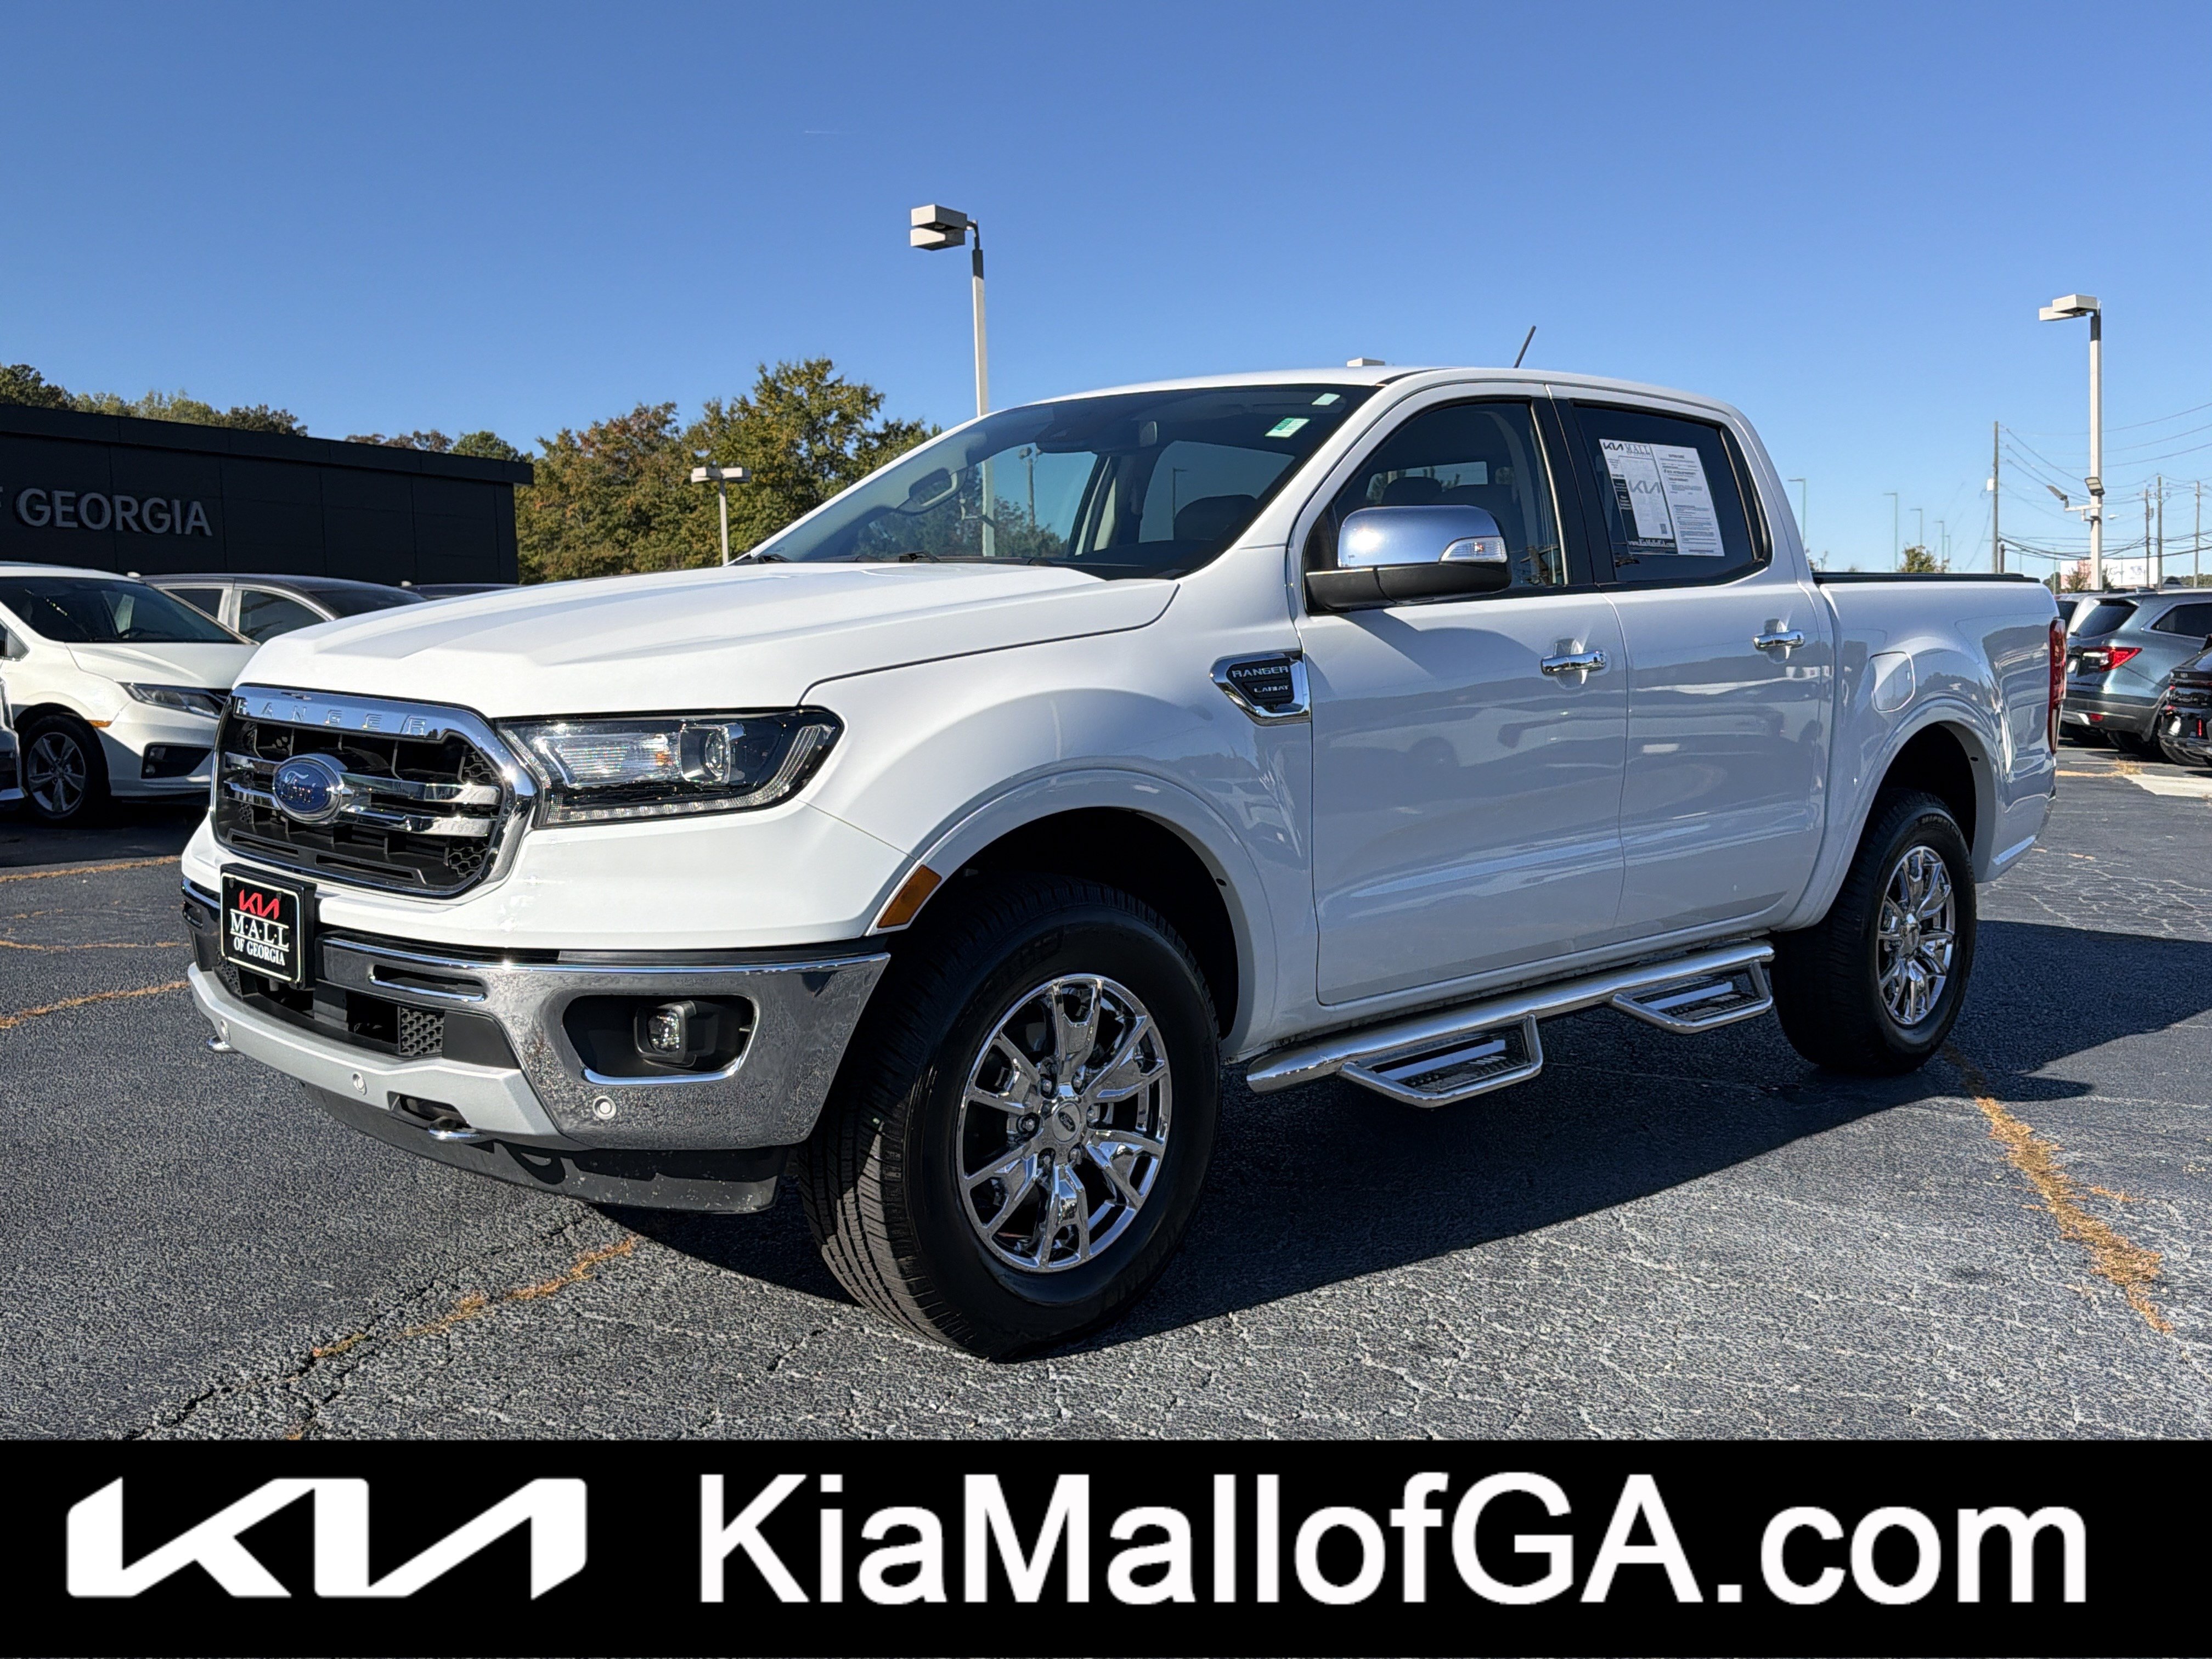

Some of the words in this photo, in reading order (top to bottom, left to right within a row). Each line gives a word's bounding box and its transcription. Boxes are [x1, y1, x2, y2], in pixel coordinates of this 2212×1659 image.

[1603, 442, 1624, 450] KIA
[1628, 480, 1661, 494] KIA
[16, 488, 212, 537] GEORGIA
[1232, 665, 1289, 678] RANGER
[235, 696, 427, 736] RANGER
[239, 889, 280, 920] KIA
[234, 936, 245, 952] OF
[246, 941, 285, 966] GEORGIA
